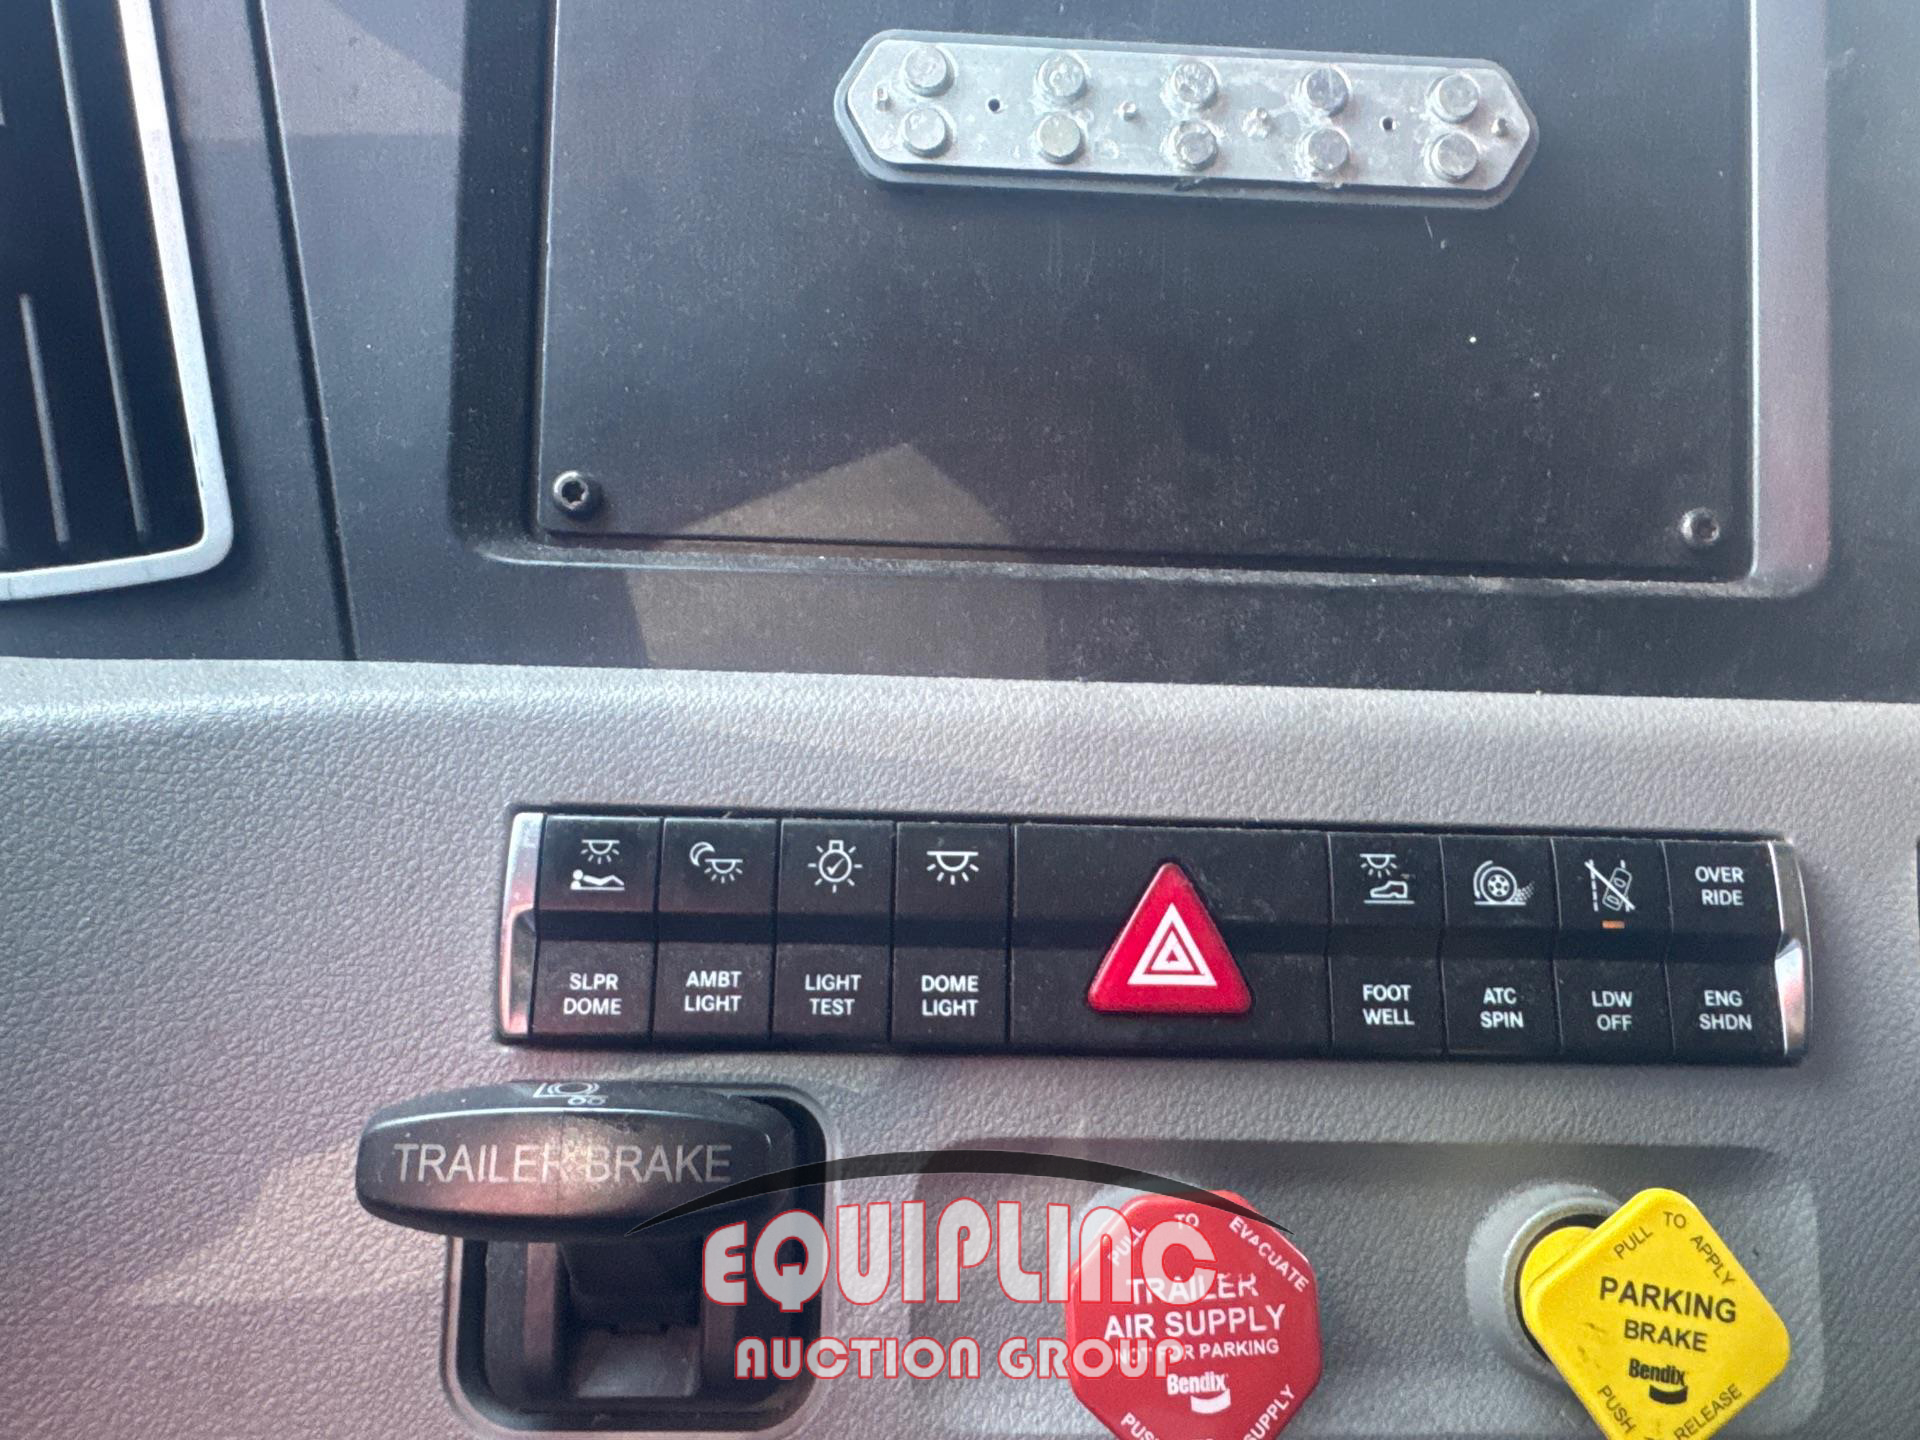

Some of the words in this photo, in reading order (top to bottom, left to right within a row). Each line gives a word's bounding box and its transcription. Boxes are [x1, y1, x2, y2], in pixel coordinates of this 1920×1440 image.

[1694, 866, 1745, 884] OVER
[1701, 889, 1744, 906] RIDE
[569, 973, 619, 992] SLPR
[685, 970, 742, 989] AMBT
[804, 974, 862, 993] LIGHT
[921, 975, 979, 994] DOME
[1362, 984, 1412, 1002] FOOT
[1483, 987, 1517, 1005] ATC
[1591, 991, 1633, 1008] LDW
[1704, 990, 1743, 1008] ENG
[563, 997, 622, 1016] DOME
[684, 995, 742, 1013] LIGHT
[809, 998, 856, 1016] TEST
[921, 999, 979, 1017] LIGHT
[1362, 1008, 1415, 1027] WELL
[1479, 1011, 1524, 1029] SPIN
[1596, 1014, 1633, 1032] OFF
[1699, 1013, 1753, 1031] SHDN
[394, 1142, 573, 1184] TRAILER
[586, 1143, 732, 1184] BRAKE
[1107, 1224, 1147, 1266] PULL
[1174, 1212, 1200, 1230] TO
[1229, 1216, 1309, 1292] EVACUATE
[1613, 1225, 1654, 1260] PULL
[1663, 1211, 1687, 1229] TO
[1690, 1235, 1736, 1286] APPLY
[1126, 1273, 1260, 1305] TRAILER
[1600, 1275, 1737, 1324] PARKING
[1104, 1313, 1156, 1341] AIR
[1165, 1304, 1286, 1337] SUPPLY
[1623, 1318, 1708, 1353] BRAKE
[1114, 1347, 1152, 1366] NOT
[1155, 1344, 1195, 1364] FOR
[1200, 1338, 1280, 1361] PARKING
[1628, 1357, 1687, 1387] Bendix
[1167, 1371, 1228, 1396] Bendix
[1597, 1384, 1636, 1434] PUSH
[1673, 1383, 1743, 1440] RELEASE
[1120, 1412, 1161, 1440] PUS
